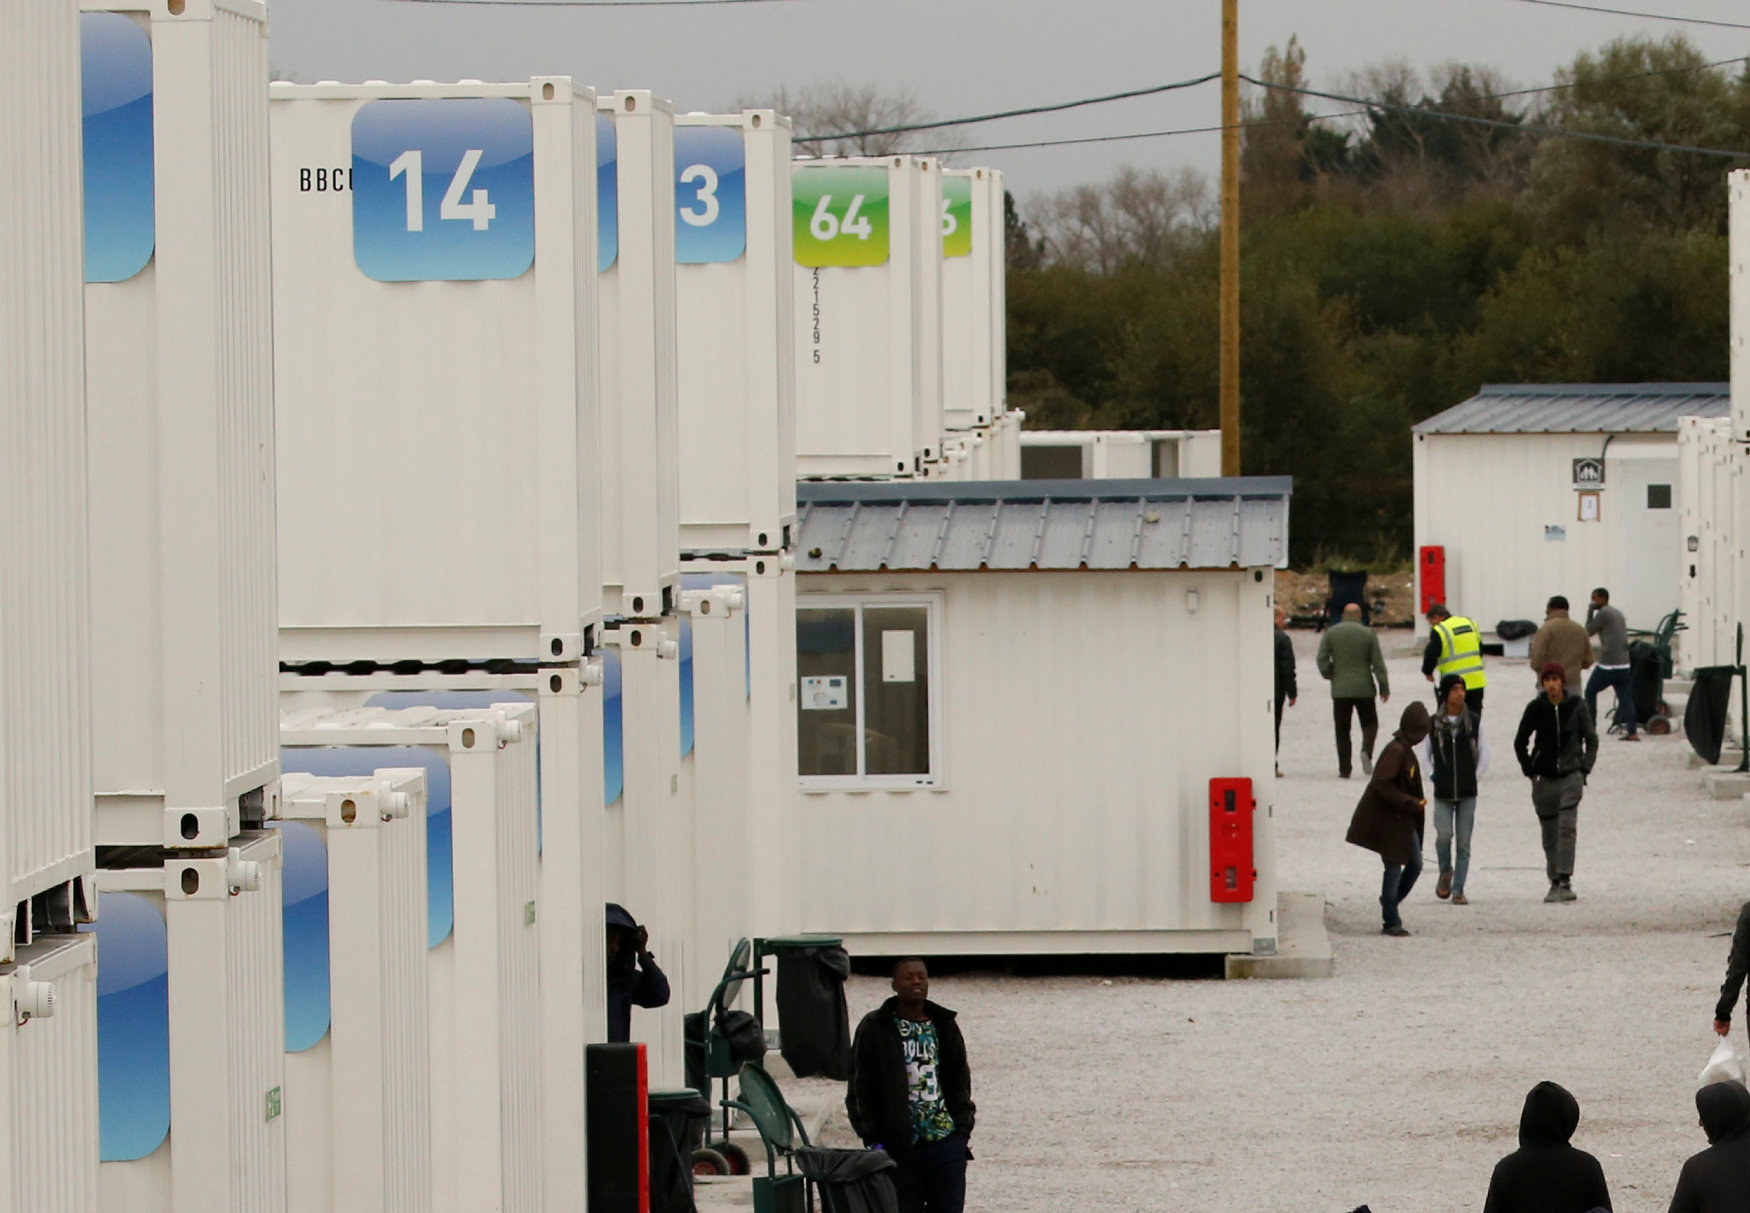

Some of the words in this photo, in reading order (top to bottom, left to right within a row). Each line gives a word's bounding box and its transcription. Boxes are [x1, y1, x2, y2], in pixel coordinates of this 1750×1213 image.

[389, 149, 496, 232] 14
[678, 163, 720, 227] 3
[809, 194, 873, 241] 64
